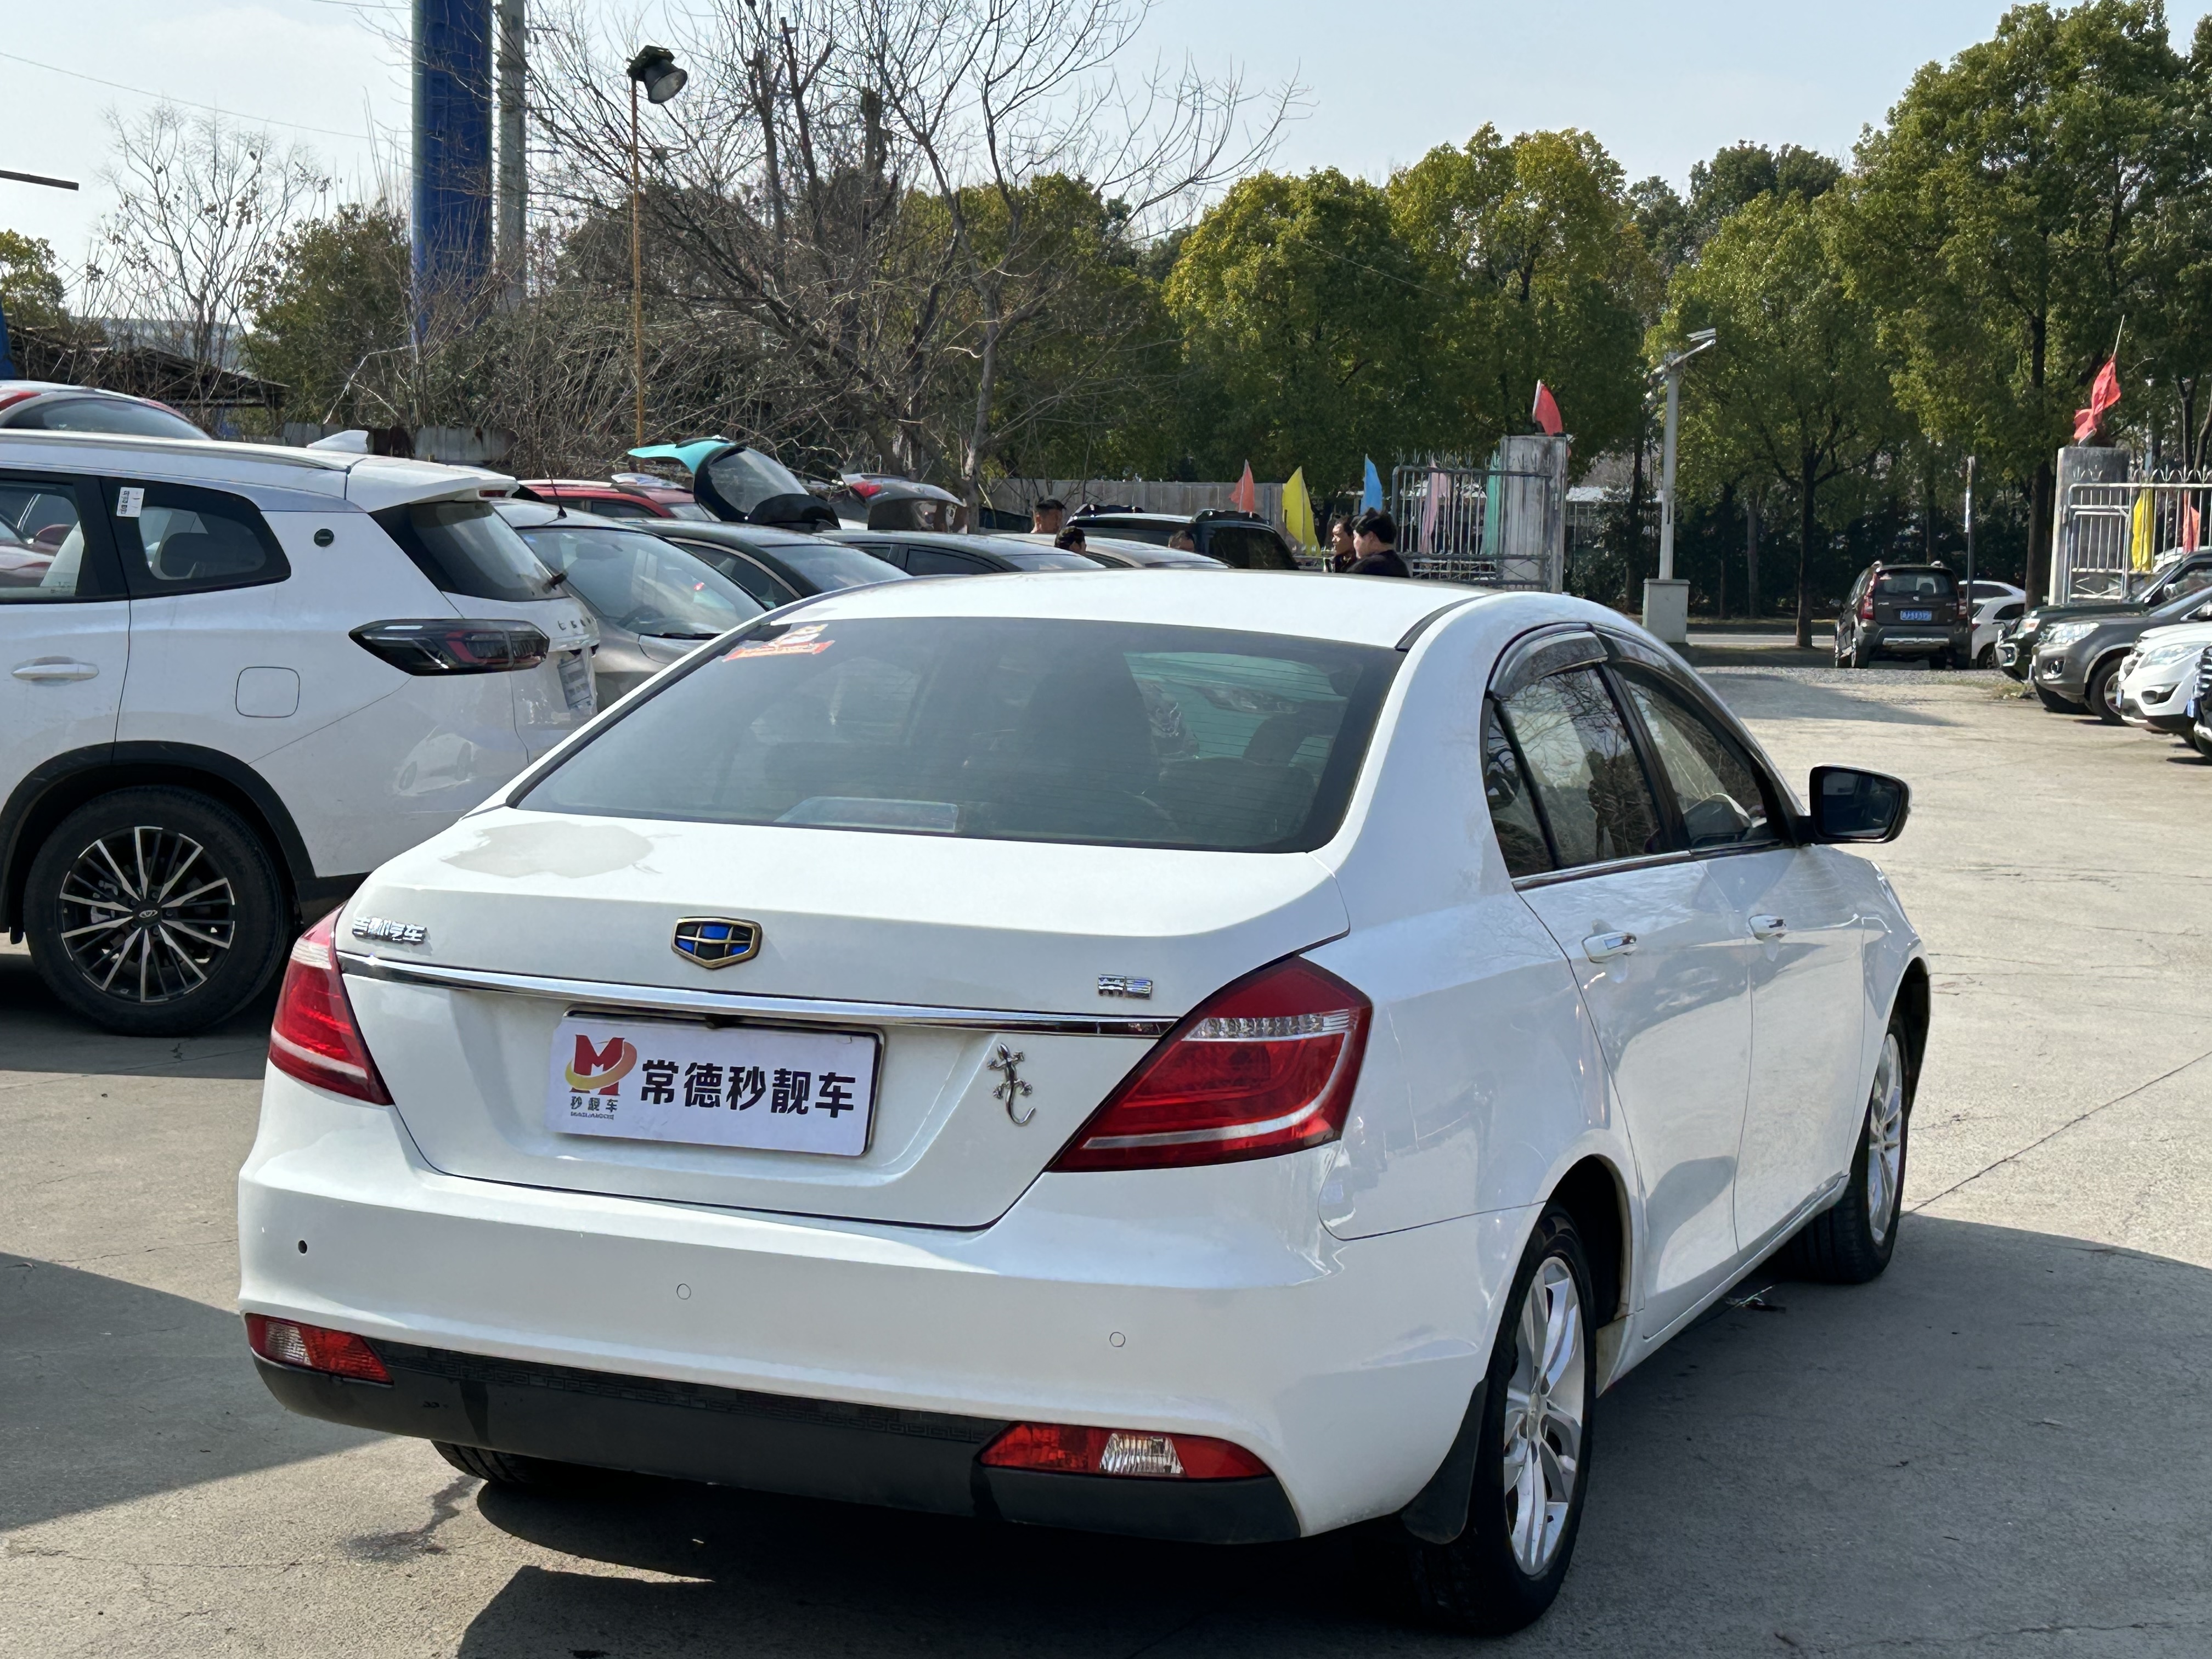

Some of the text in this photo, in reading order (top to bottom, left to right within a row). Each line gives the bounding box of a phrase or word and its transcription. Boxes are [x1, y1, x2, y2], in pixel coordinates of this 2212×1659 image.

[640, 1059, 856, 1118] 常德秒靓车
